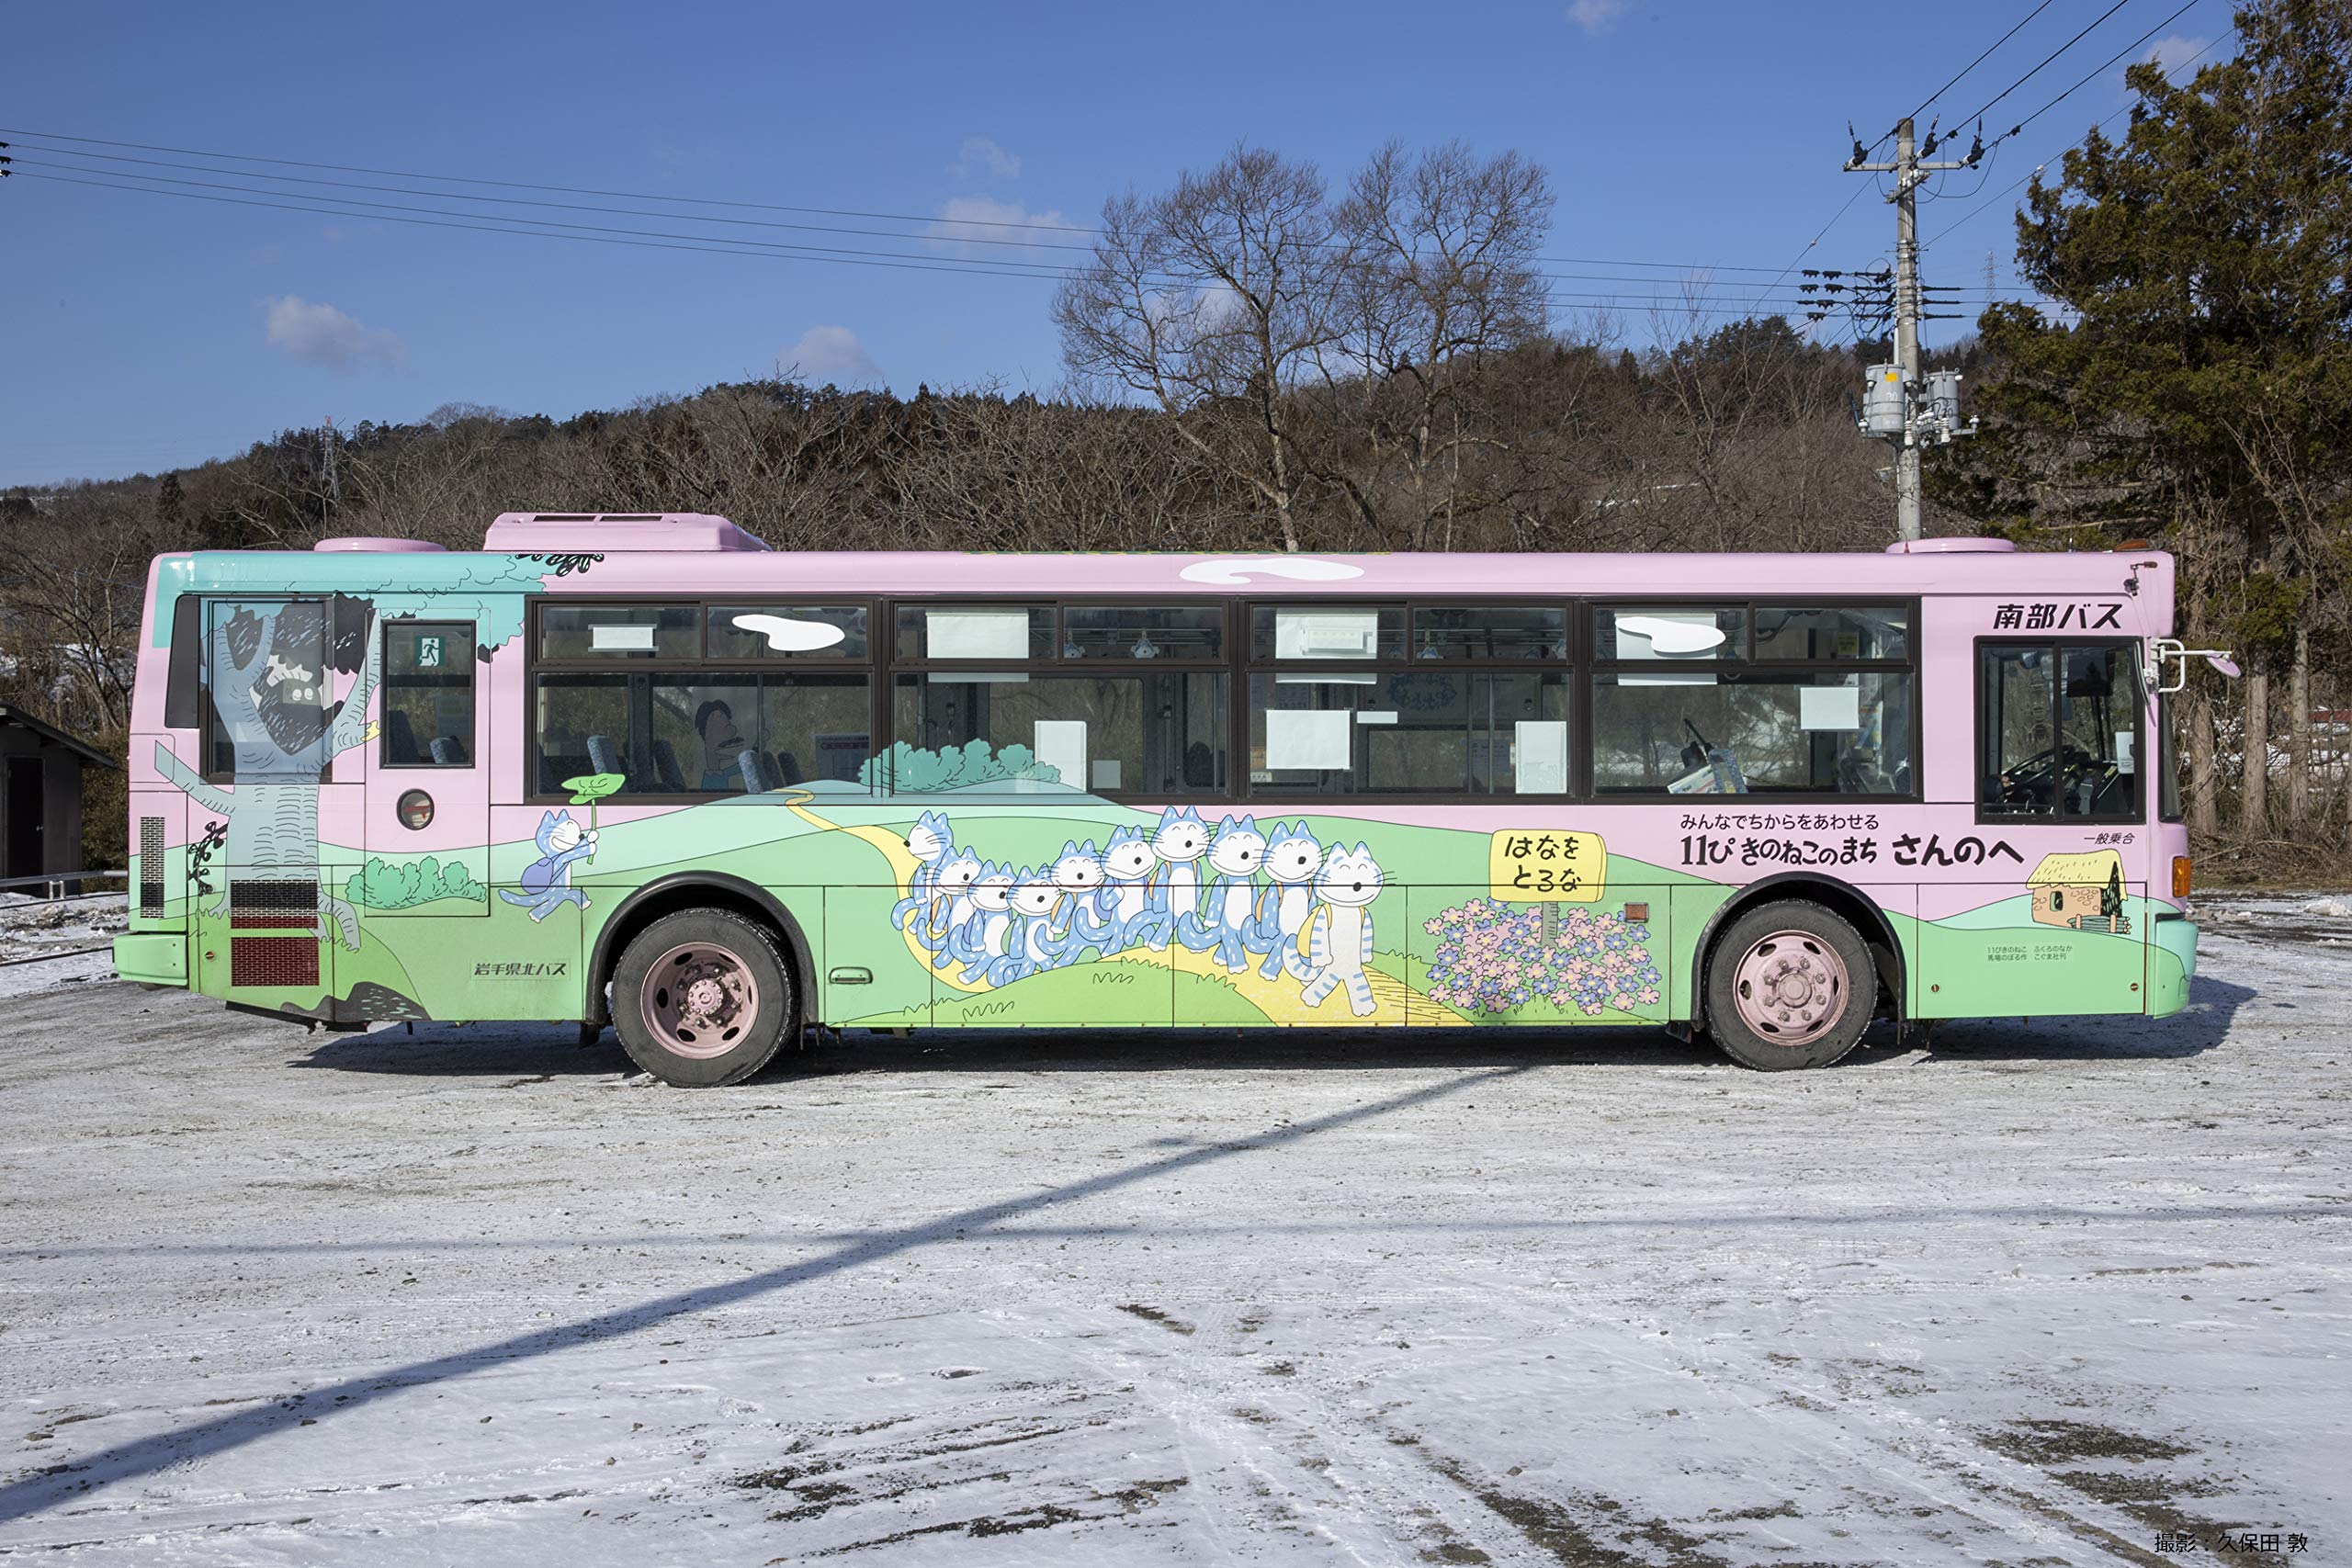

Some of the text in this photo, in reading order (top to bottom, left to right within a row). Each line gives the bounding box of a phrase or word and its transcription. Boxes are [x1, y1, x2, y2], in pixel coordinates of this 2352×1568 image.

[1993, 603, 2123, 630] 南部バス
[1680, 813, 1880, 830] みんなでちからをあわせる
[1504, 834, 1579, 861] はなを
[1892, 833, 2025, 866] さんのへ
[2084, 832, 2136, 845] 一般乗合
[1512, 864, 1582, 893] とろな
[474, 963, 567, 976] 岩手県北バス
